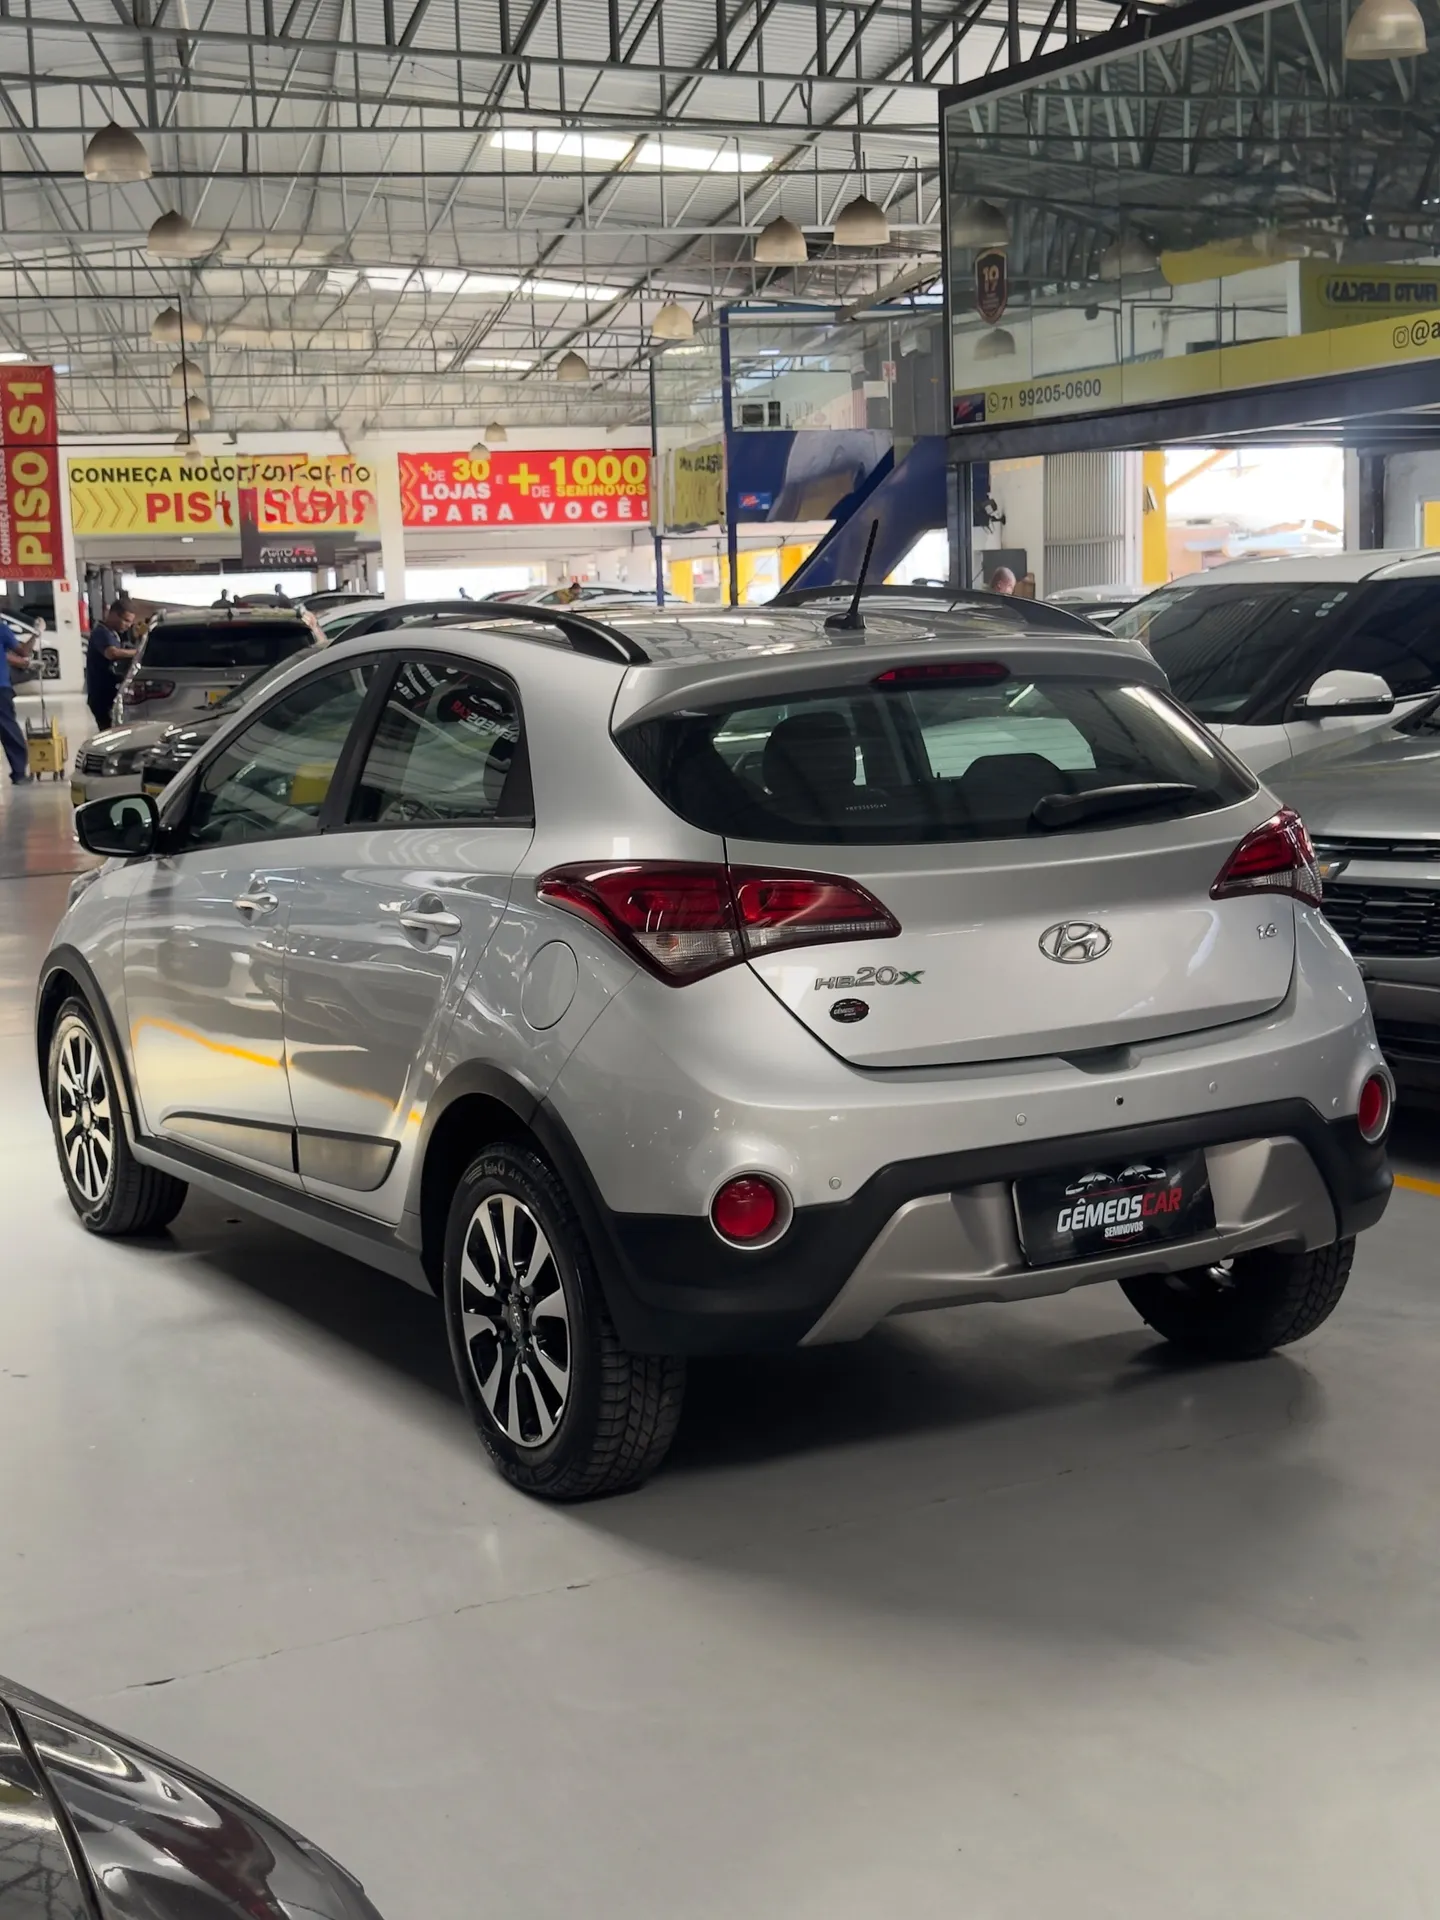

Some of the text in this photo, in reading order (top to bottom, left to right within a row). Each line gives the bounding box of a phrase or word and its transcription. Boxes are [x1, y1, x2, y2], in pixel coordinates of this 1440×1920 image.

[1001, 396, 1014, 410] 71
[1018, 378, 1101, 407] 99205-0600
[7, 382, 53, 566] PISO S1
[70, 467, 173, 488] CONHEÇA
[452, 458, 491, 482] 30
[549, 454, 648, 486] 1000
[420, 482, 492, 501] LOJAS
[531, 483, 648, 498] DE SEMINOVOS
[422, 502, 514, 523] PARA
[814, 965, 926, 991] HB20X
[1056, 1187, 1183, 1234] GÊMEOSCAR
[1104, 1220, 1145, 1239] SEMINOVOS
